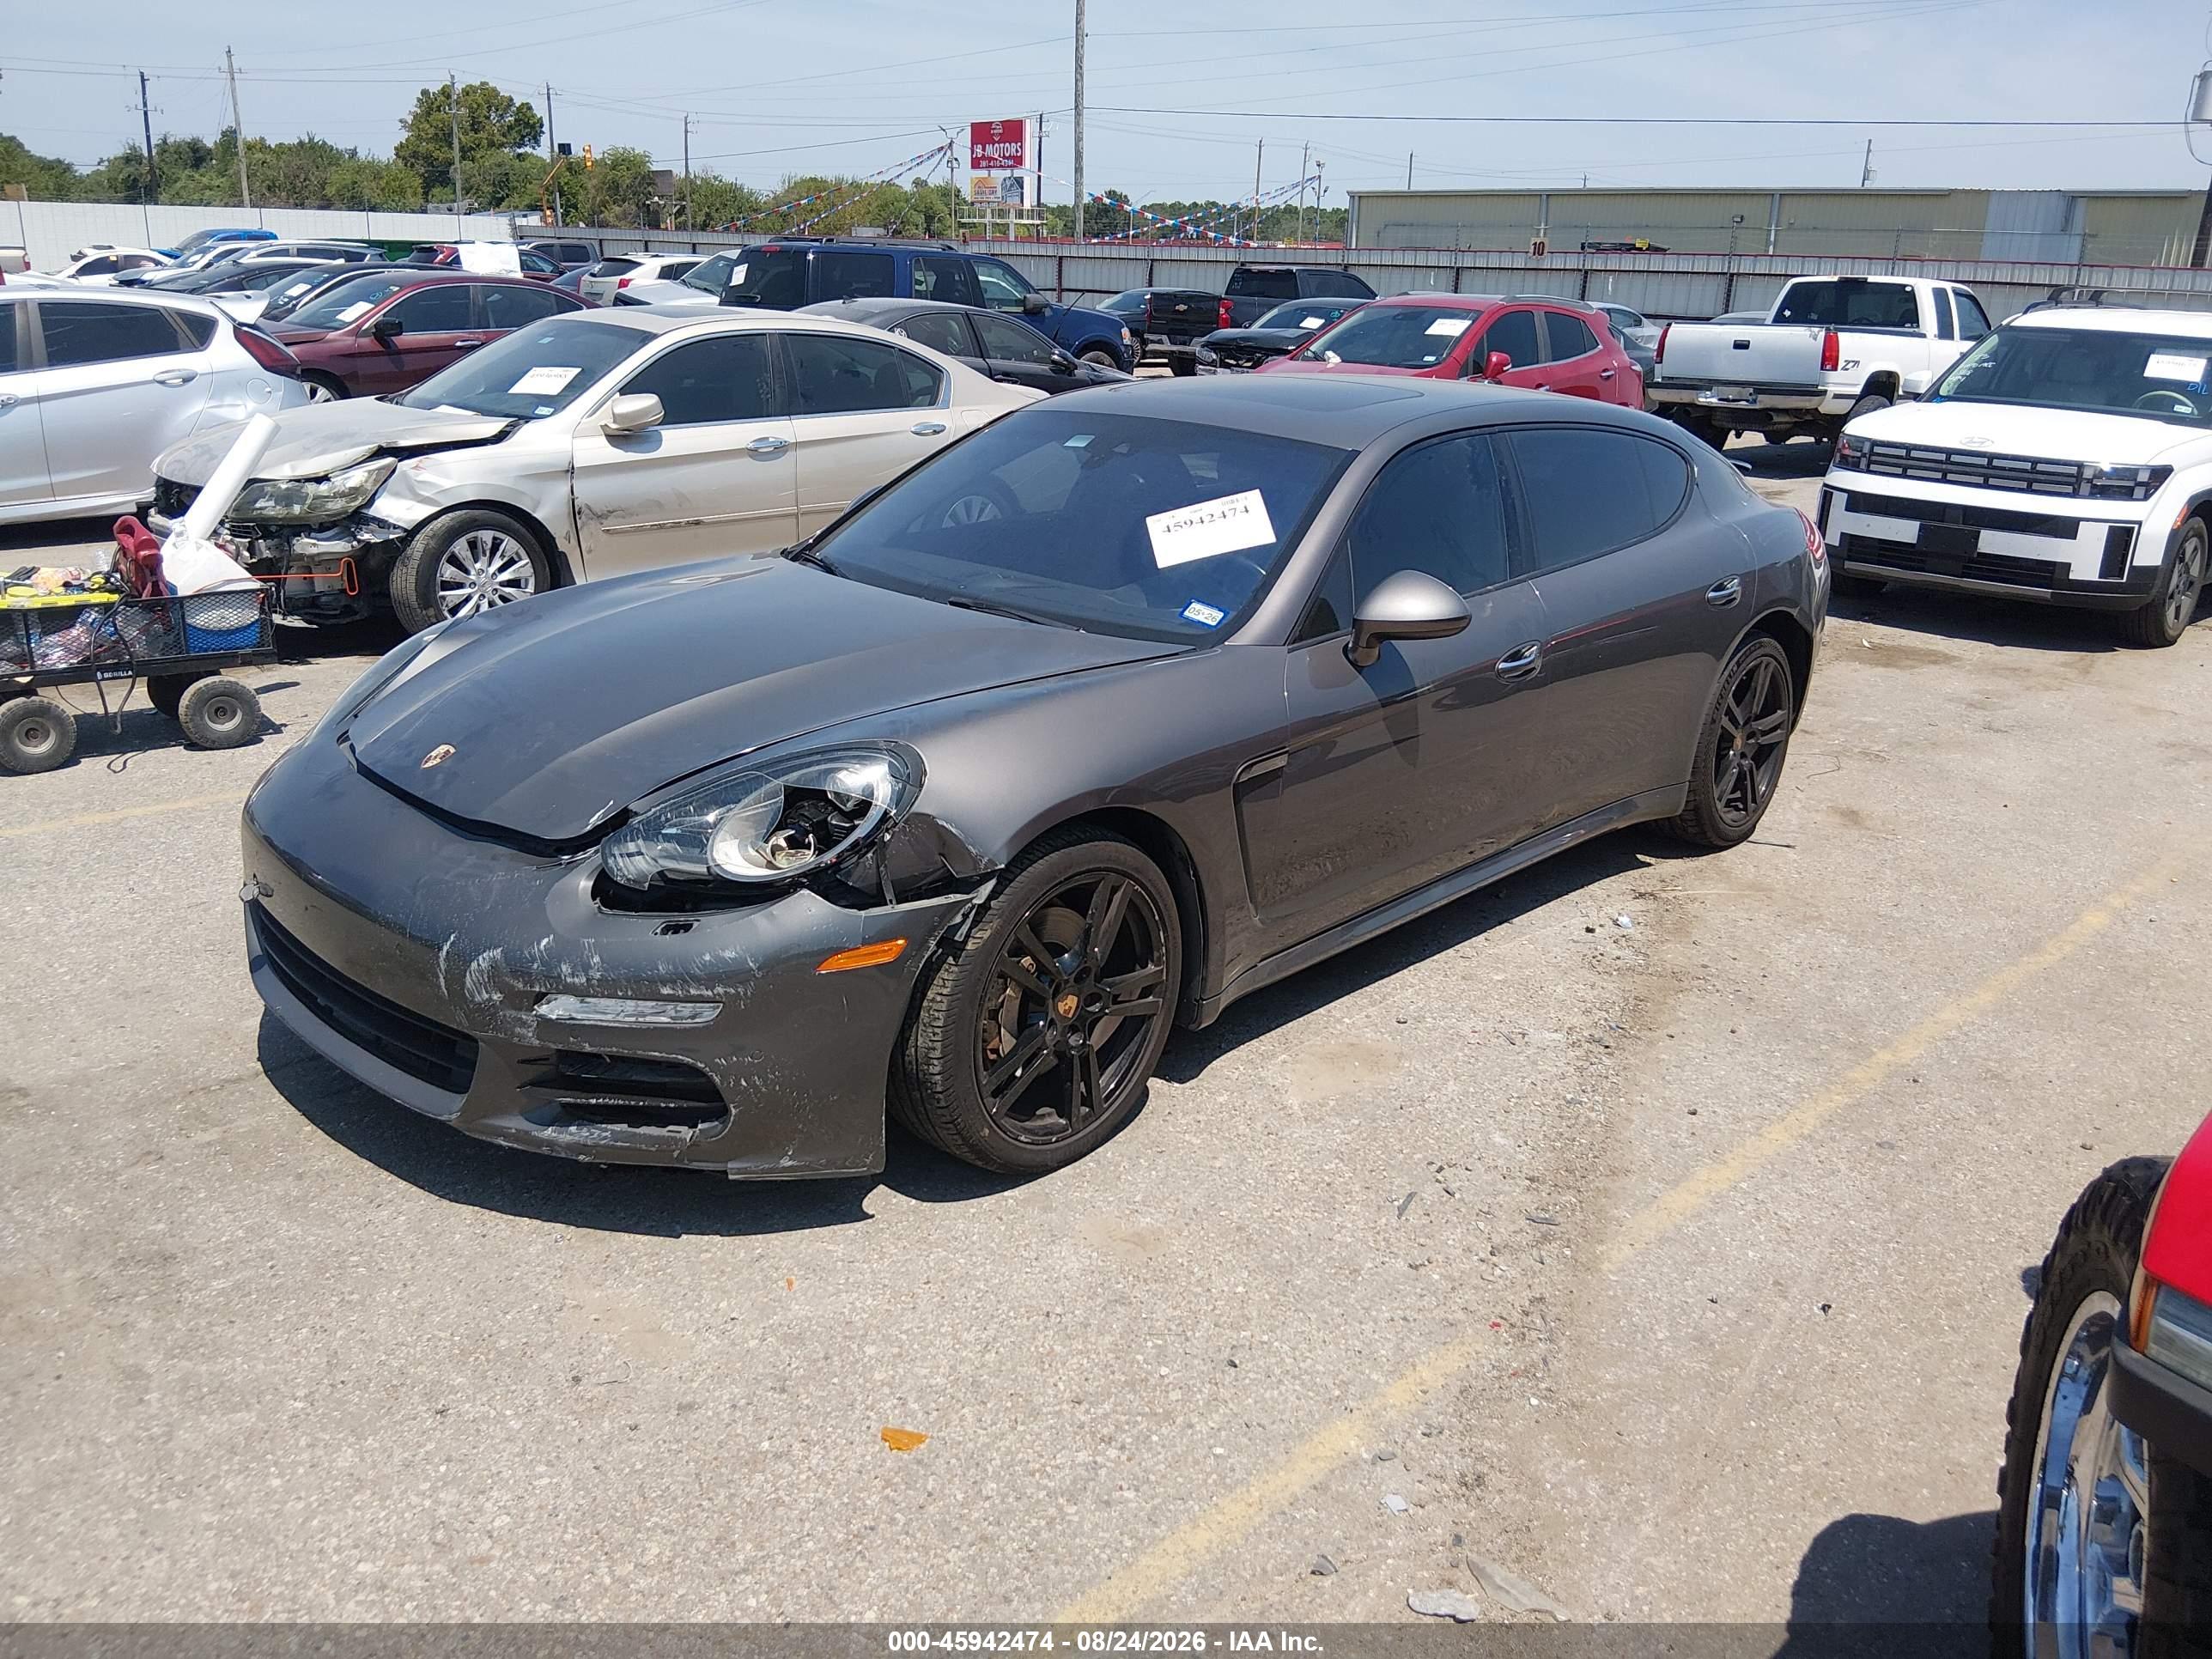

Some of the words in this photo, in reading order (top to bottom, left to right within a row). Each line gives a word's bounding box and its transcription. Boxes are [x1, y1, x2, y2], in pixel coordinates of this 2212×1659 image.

[985, 142, 1022, 157] MOTORS
[1531, 240, 1546, 257] 10
[1162, 504, 1250, 533] 45942474
[103, 670, 133, 678] GORILLA
